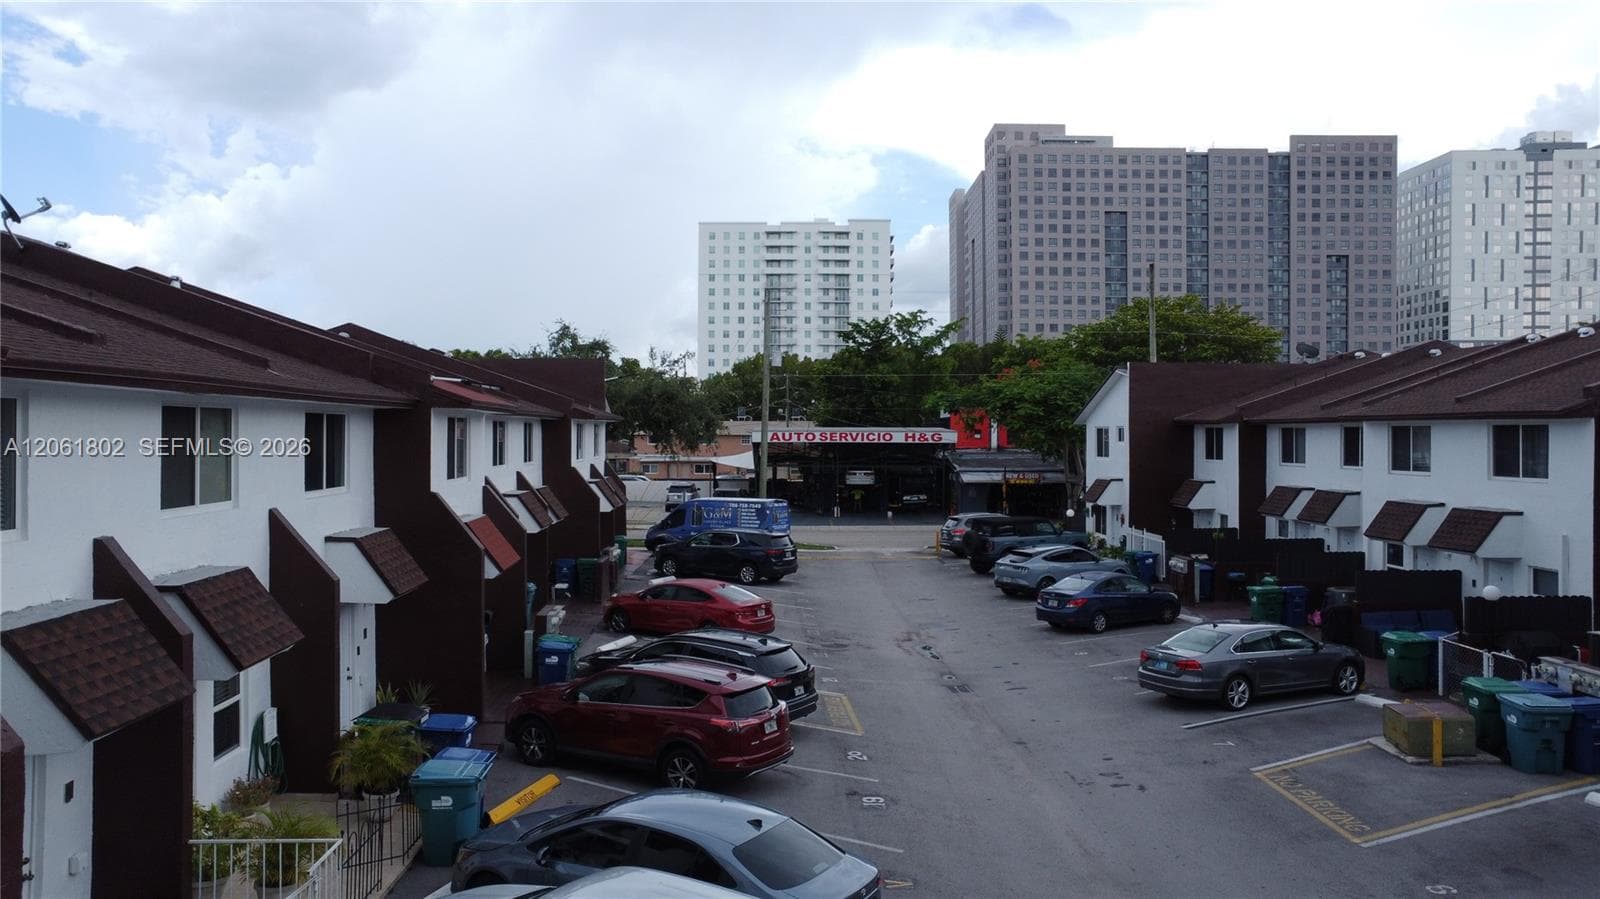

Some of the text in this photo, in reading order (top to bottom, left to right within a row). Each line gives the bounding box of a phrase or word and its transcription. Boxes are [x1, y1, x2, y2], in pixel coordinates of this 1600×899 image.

[770, 432, 943, 442] AUTO SERVICIO H&G
[514, 790, 537, 806] VISITOR
[862, 796, 885, 807] 19
